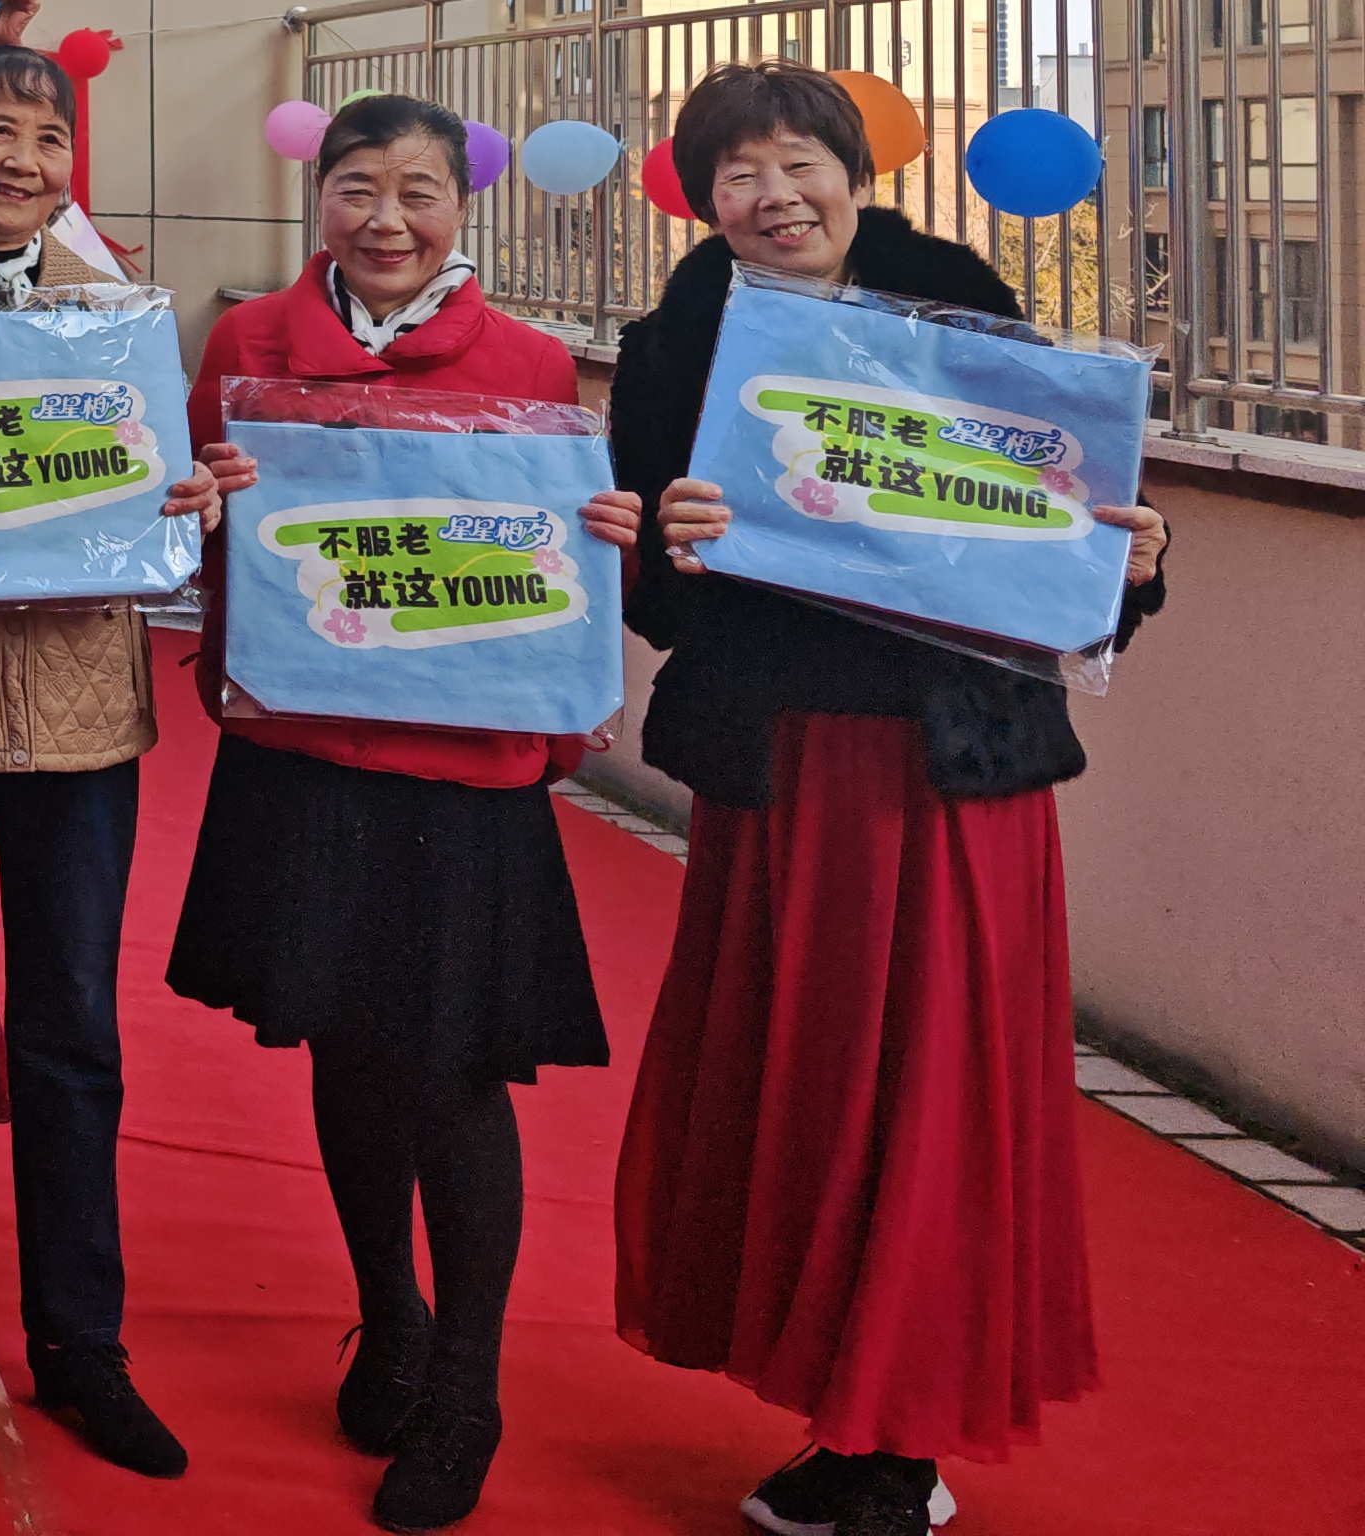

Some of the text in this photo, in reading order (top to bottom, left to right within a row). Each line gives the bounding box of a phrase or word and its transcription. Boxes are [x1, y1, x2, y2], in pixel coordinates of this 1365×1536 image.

[804, 399, 929, 449] 不服老
[317, 523, 431, 559] 不服老
